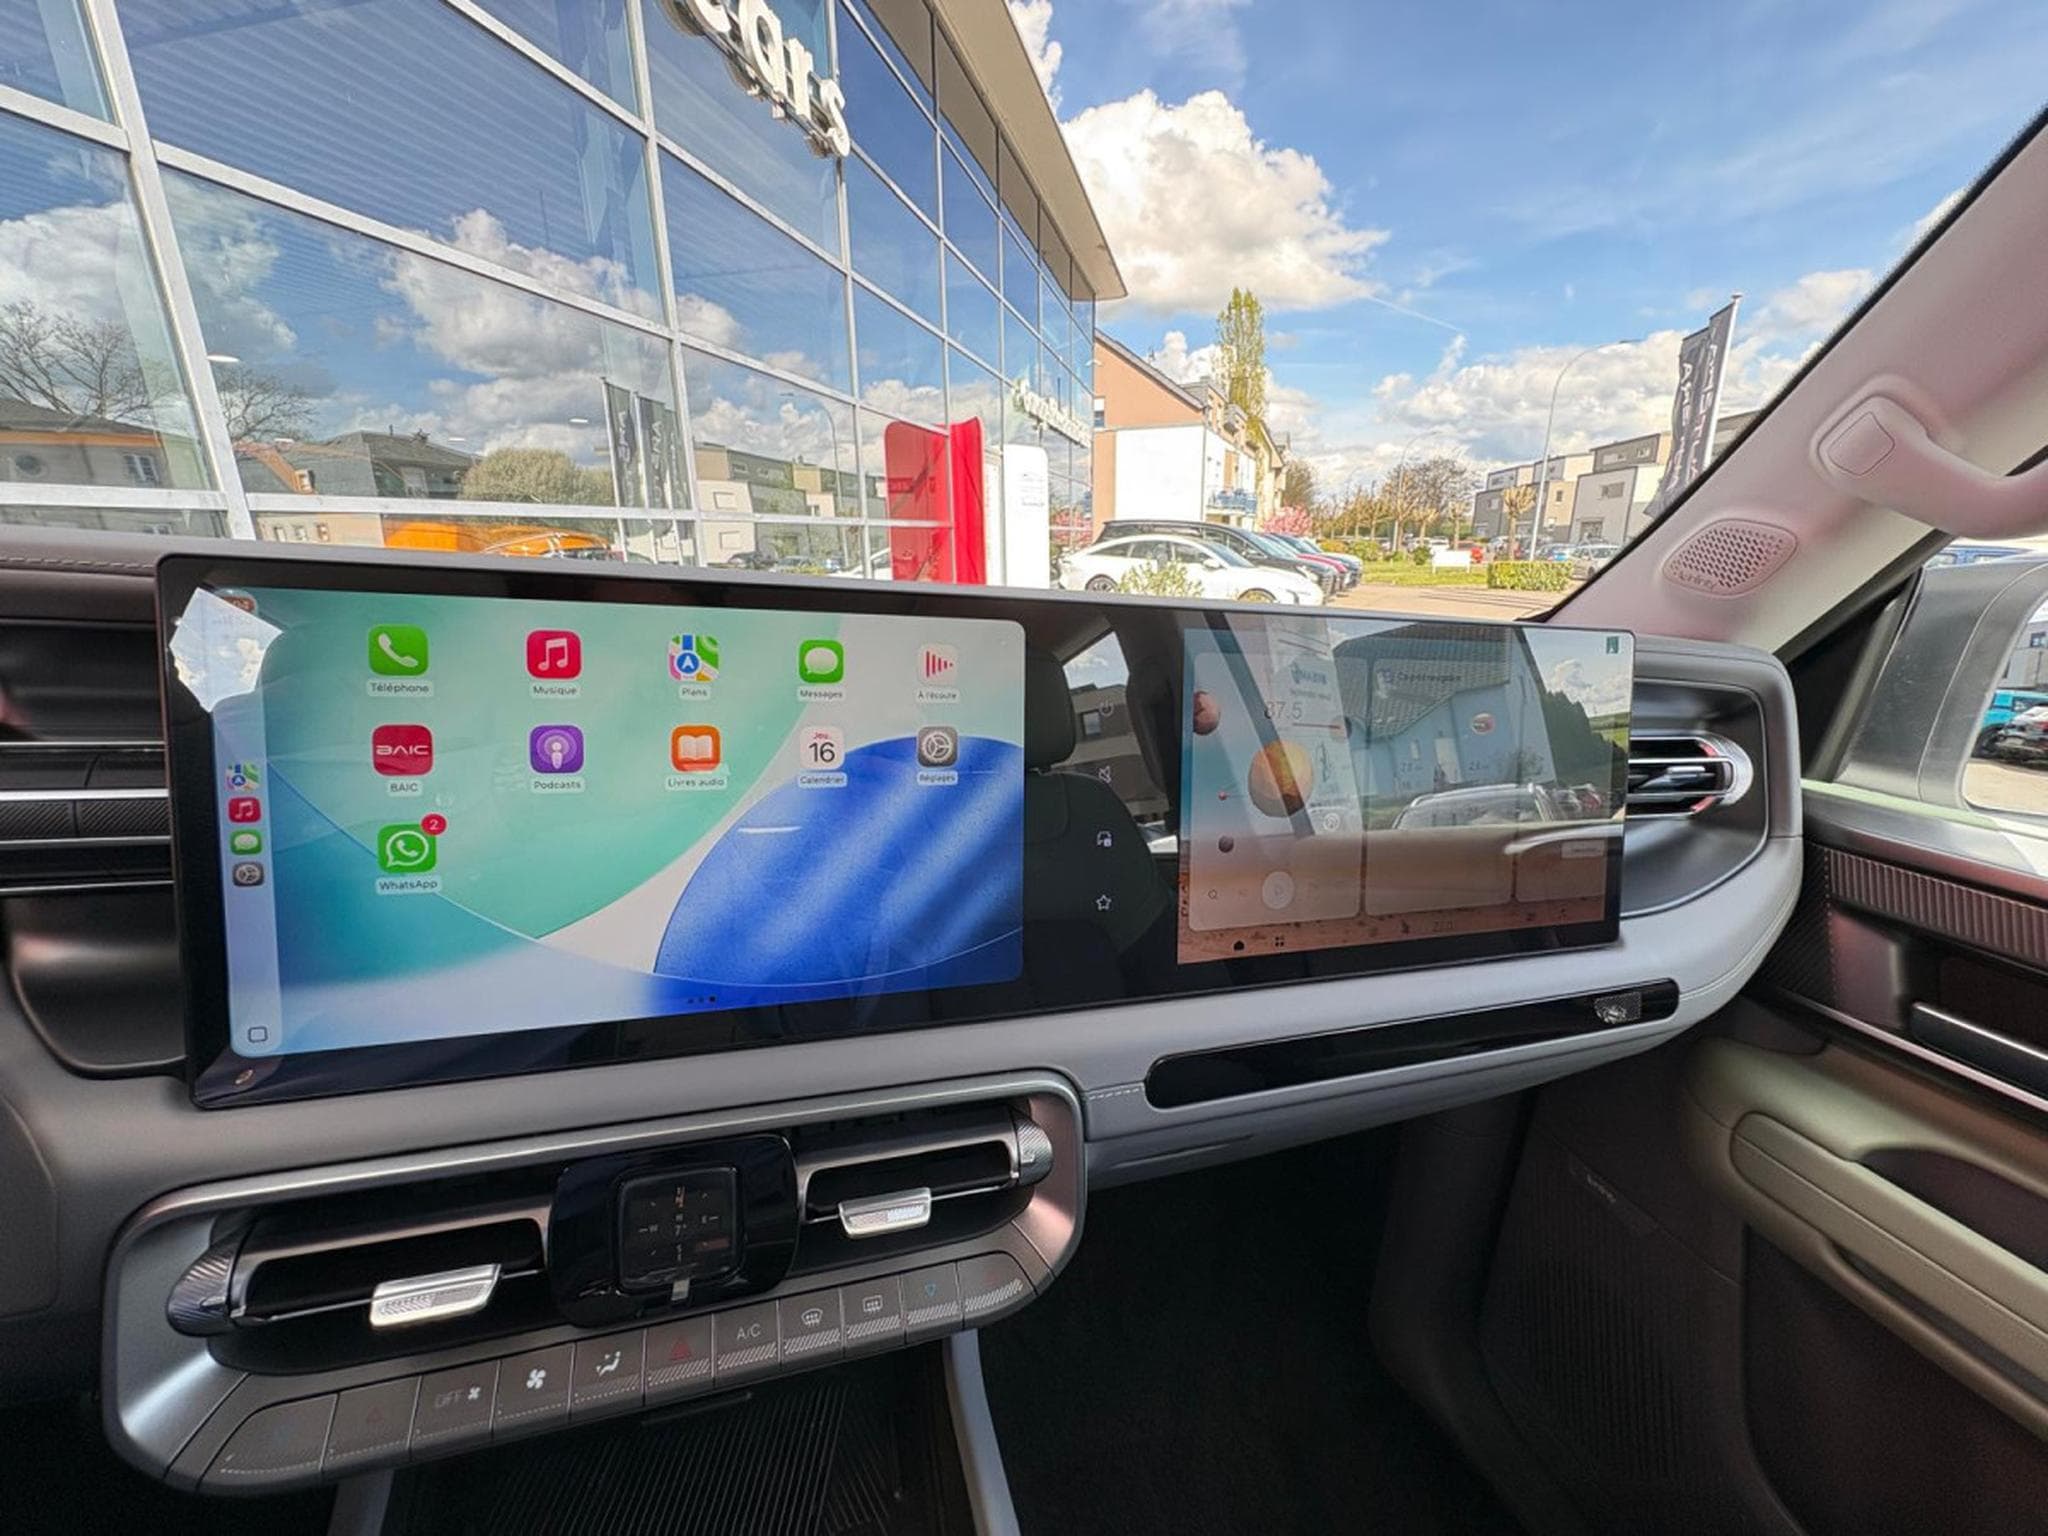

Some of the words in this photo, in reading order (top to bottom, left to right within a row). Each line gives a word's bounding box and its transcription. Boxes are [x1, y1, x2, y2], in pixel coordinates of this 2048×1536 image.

[371, 682, 429, 694] Téléphone
[533, 685, 577, 697] Musique
[681, 687, 708, 697] Plans
[800, 688, 843, 701] Messages
[376, 744, 429, 756] BAIC
[809, 741, 836, 763] 16
[534, 780, 581, 791] Podcasts
[667, 776, 694, 788] Livres
[698, 776, 724, 787] audio
[800, 775, 845, 786] Calendrier
[390, 783, 418, 793] BAIC
[429, 819, 438, 830] 2
[379, 878, 438, 893] WhatsApp
[736, 1323, 762, 1340] A/C
